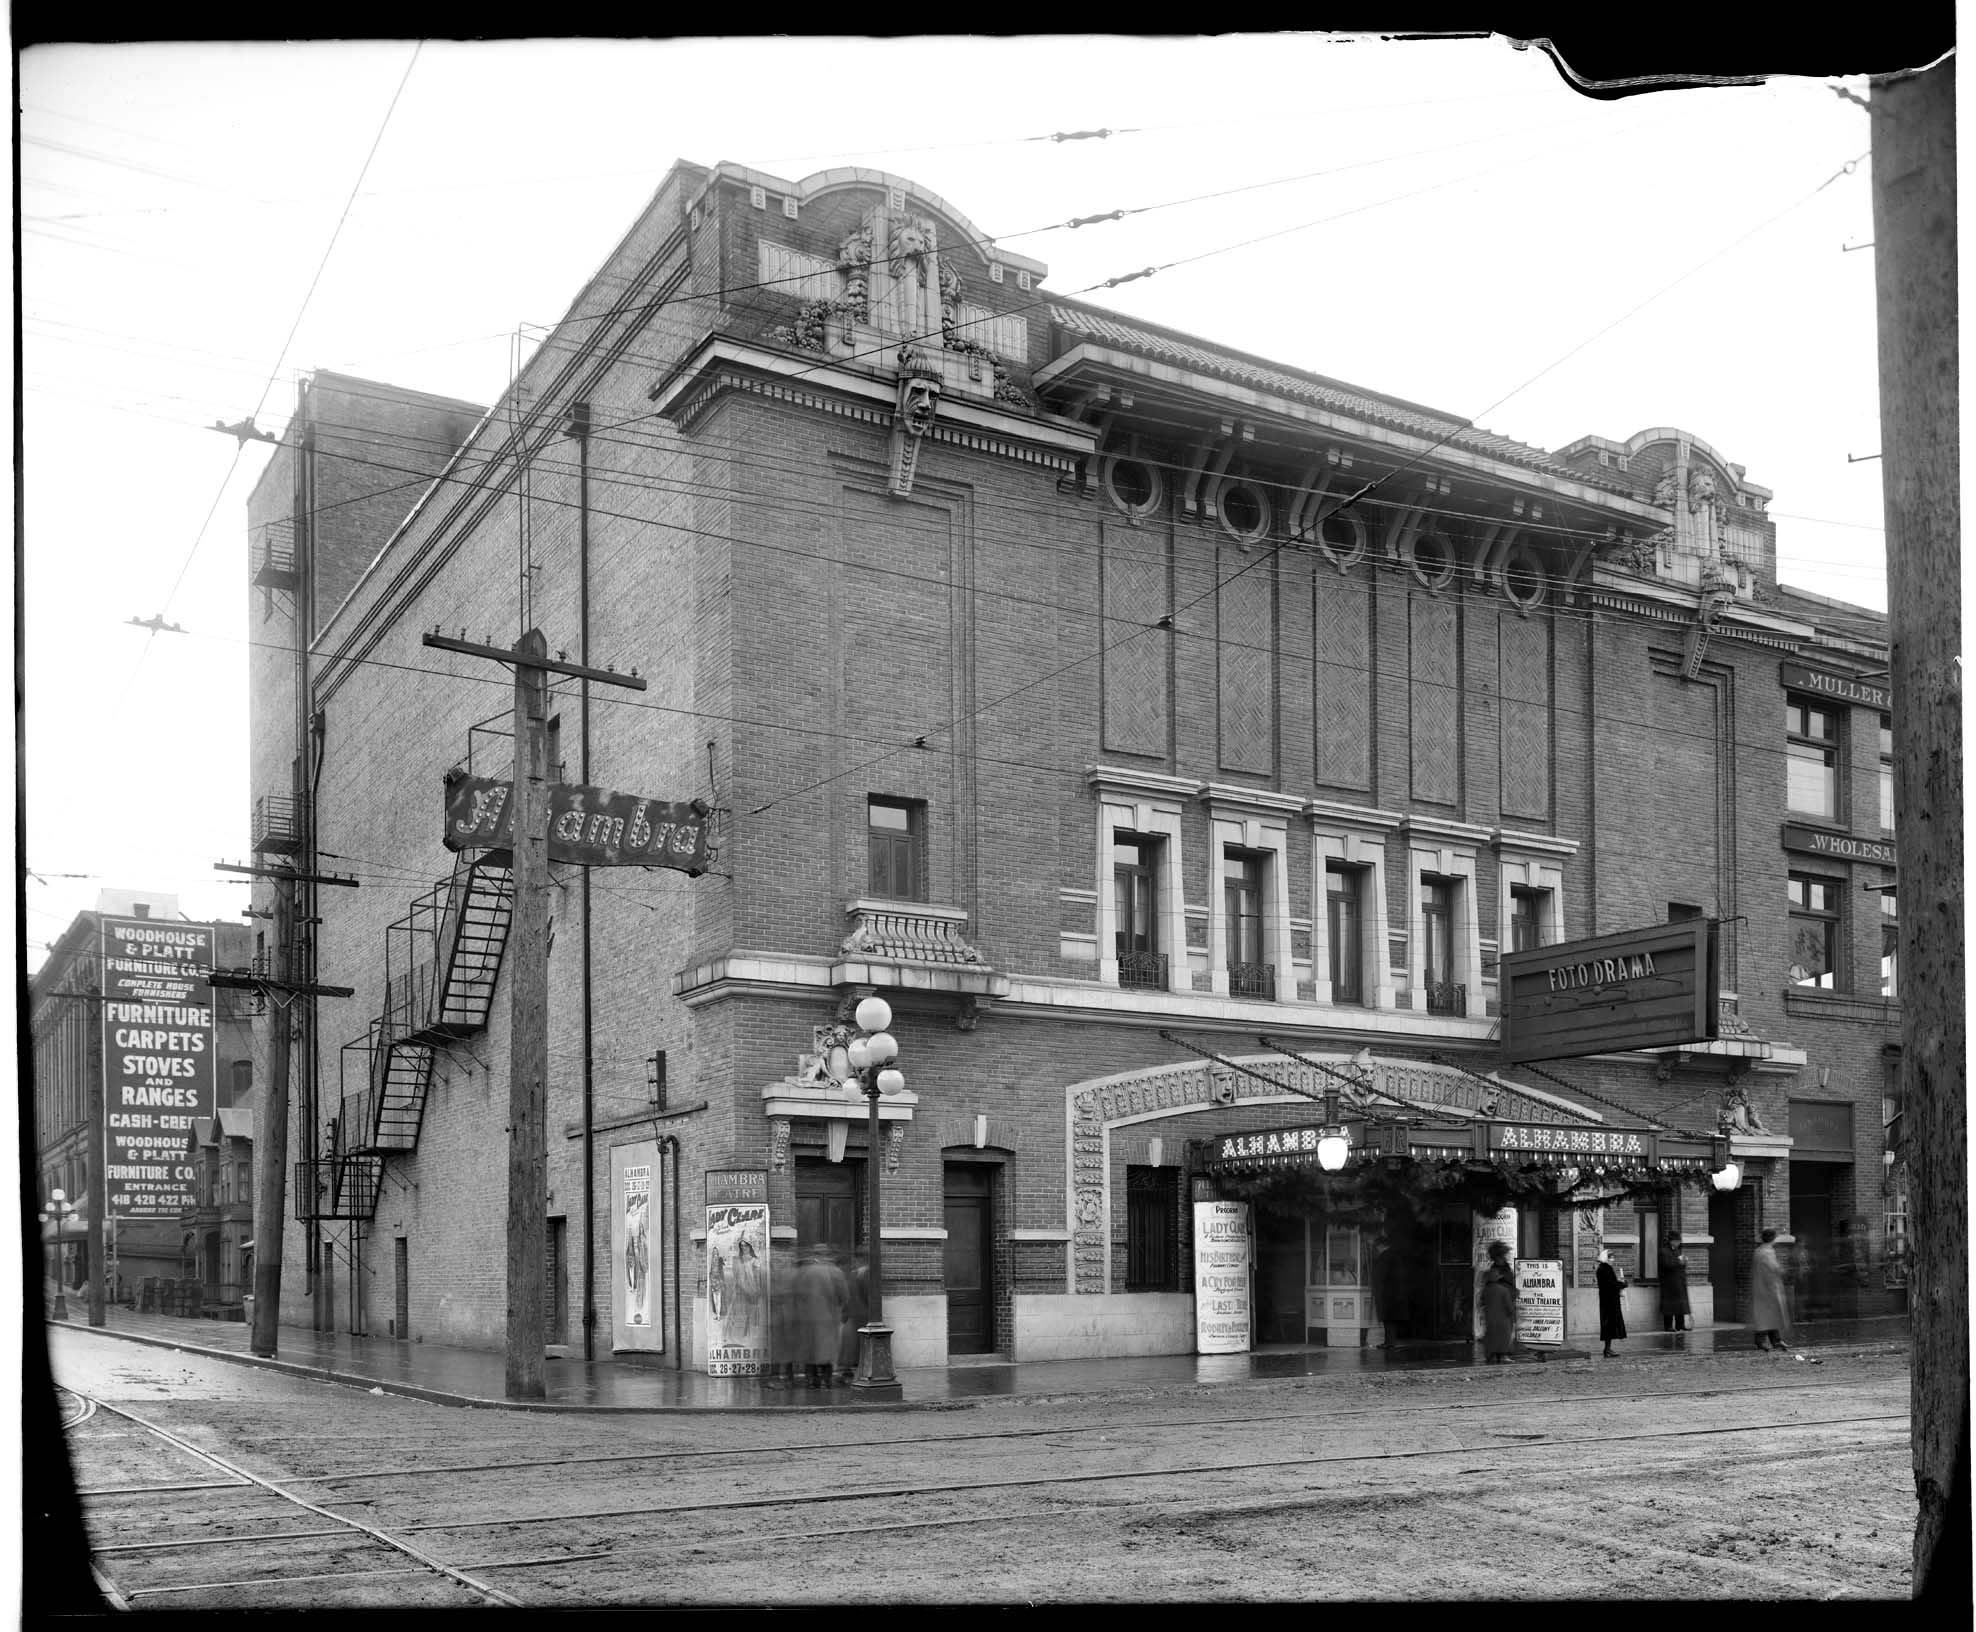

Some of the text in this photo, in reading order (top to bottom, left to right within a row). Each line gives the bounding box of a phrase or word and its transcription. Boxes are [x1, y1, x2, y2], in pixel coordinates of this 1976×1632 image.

[1808, 672, 1883, 705] MULLER
[456, 786, 699, 854] Aambra
[114, 927, 206, 946] WOODHOUSE
[126, 943, 195, 960] & PLATT
[106, 958, 179, 976] FURNITURE
[1548, 952, 1656, 991] FOTO DRAMA
[117, 979, 195, 991] COMPLETE HOUSE
[107, 1003, 211, 1027] FURNITURE
[115, 1029, 204, 1052] CARPETS
[123, 1055, 196, 1077] STOVES
[146, 1078, 173, 1086] AND
[122, 1086, 198, 1107] RANGES
[115, 1136, 189, 1149] WOODHOUS
[1500, 1127, 1642, 1153] ALHAMBRA
[128, 1149, 188, 1160] & PLATT
[107, 1165, 168, 1179] FURNITURE
[124, 1183, 188, 1191] ENTRANCE
[1522, 1278, 1556, 1288] ALHAMBRA
